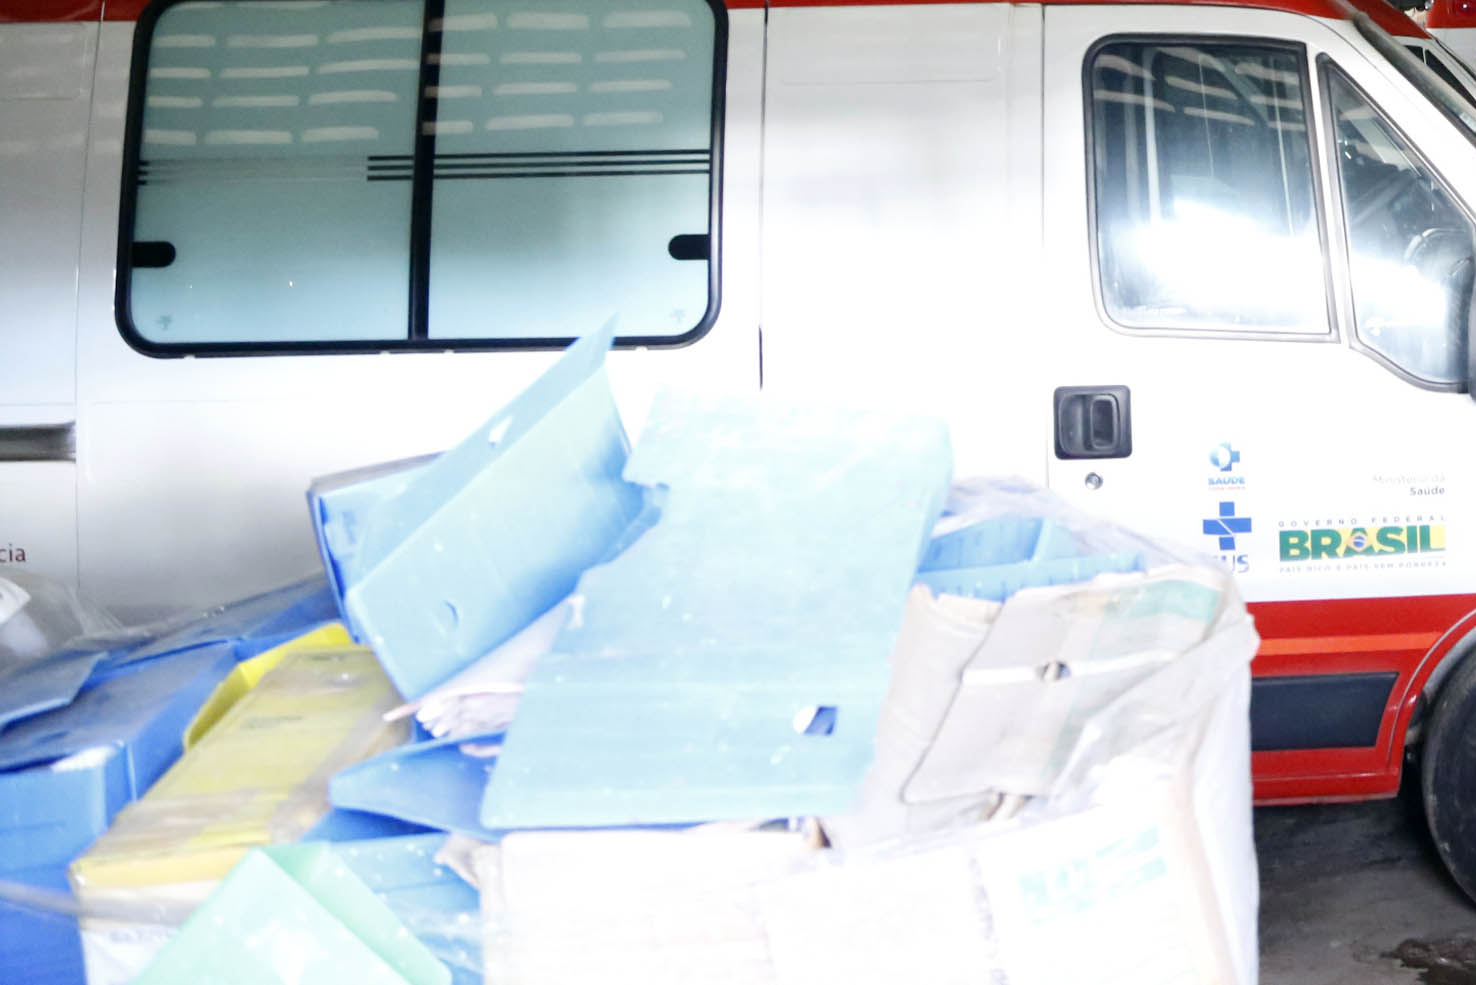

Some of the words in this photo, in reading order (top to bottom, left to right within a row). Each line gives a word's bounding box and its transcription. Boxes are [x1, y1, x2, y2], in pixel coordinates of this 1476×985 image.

[1278, 517, 1358, 527] GOVERNO
[1371, 514, 1446, 524] FEDERAL
[1278, 524, 1446, 562] BRASIL
